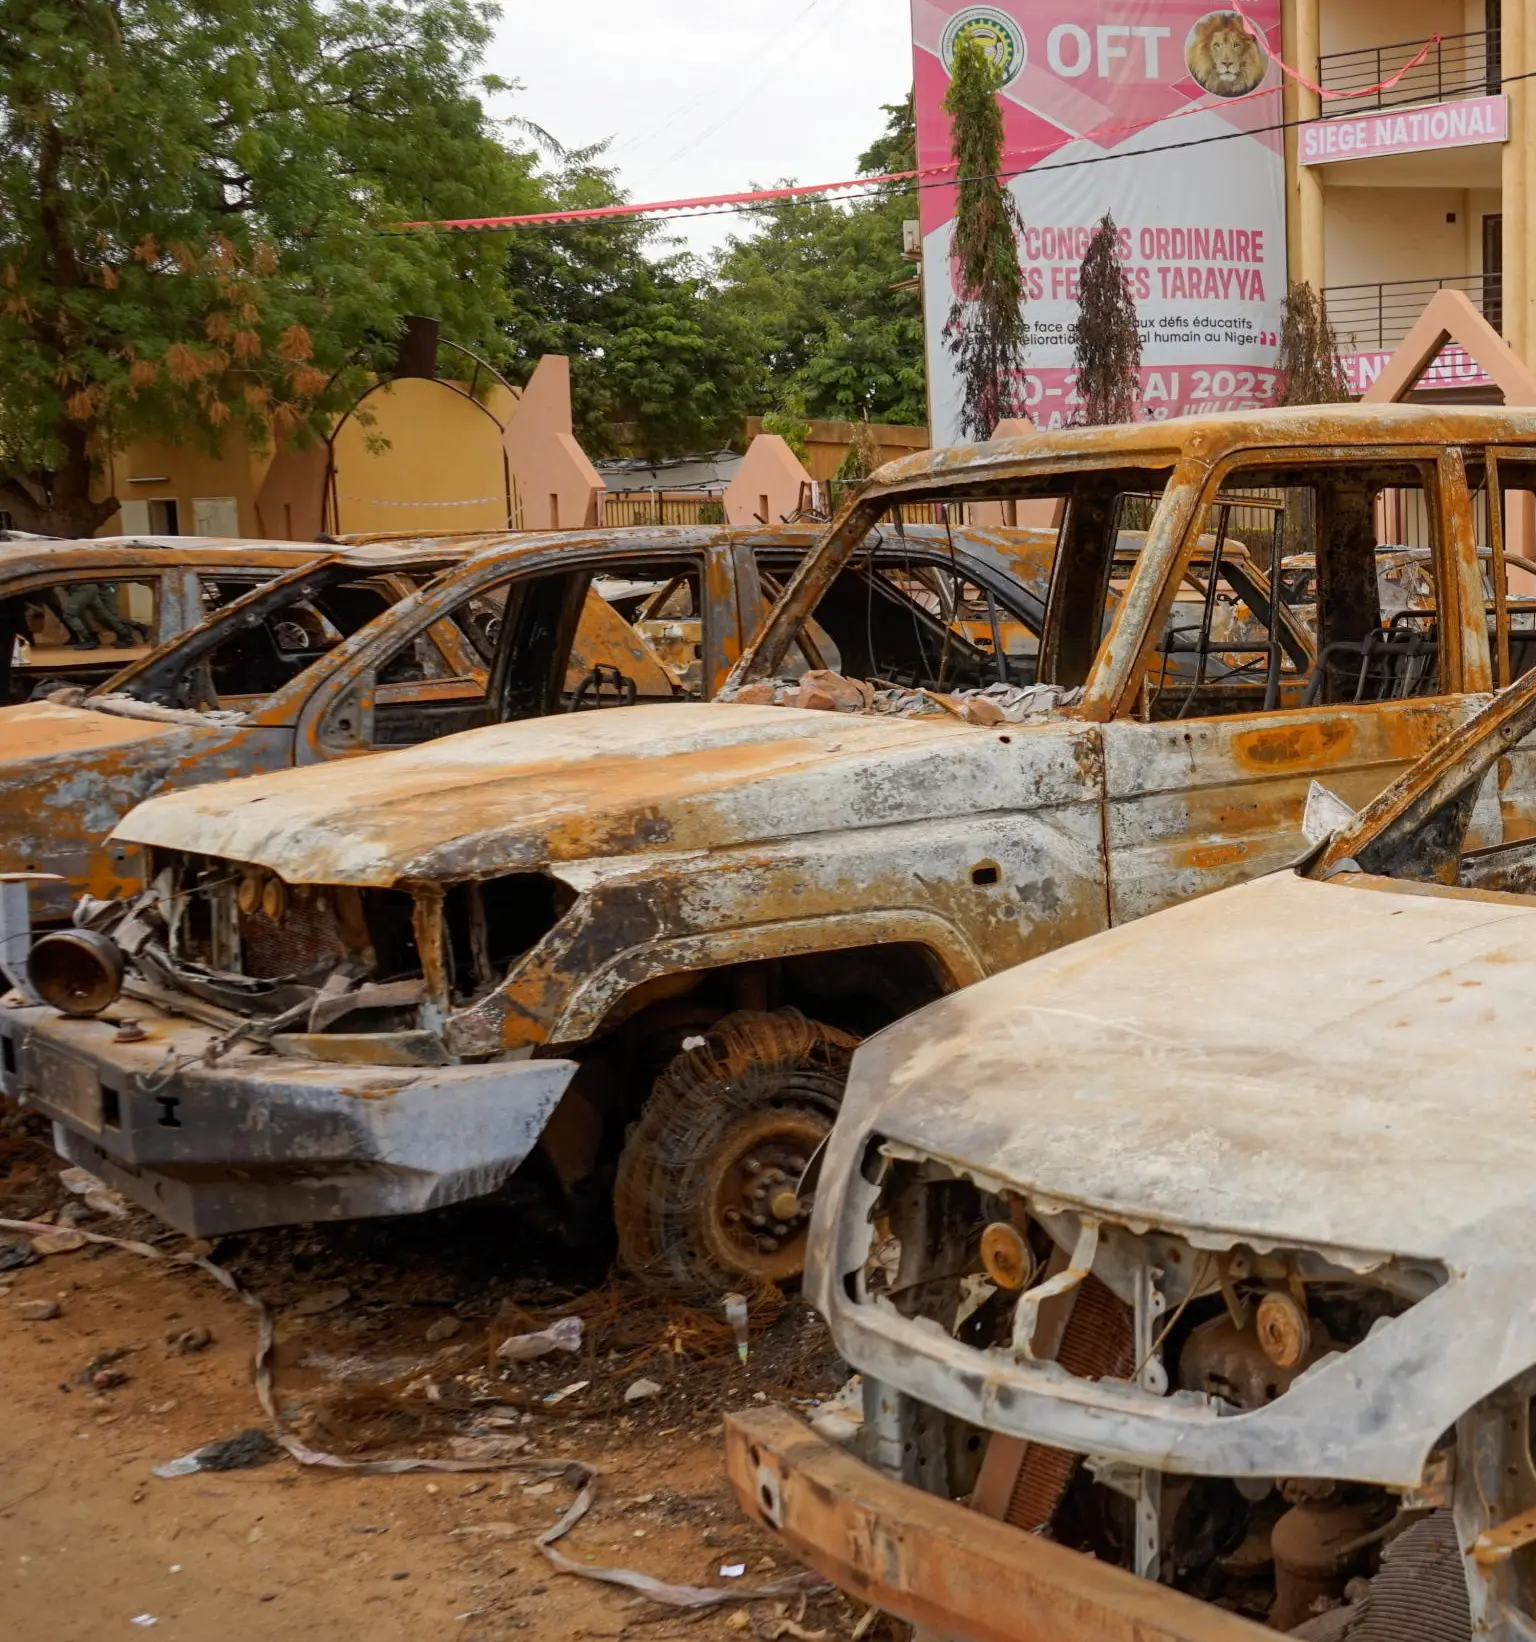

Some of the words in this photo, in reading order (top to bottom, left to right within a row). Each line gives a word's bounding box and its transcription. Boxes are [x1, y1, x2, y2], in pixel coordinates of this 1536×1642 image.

[1046, 23, 1171, 78] OFT
[1305, 121, 1367, 156] SIEGE
[1375, 104, 1496, 146] NATIONAL
[1026, 226, 1133, 262] CONGS
[1140, 227, 1264, 263] ORDINAIRE
[1051, 267, 1150, 301] FEES
[1157, 266, 1265, 302] TARAYYA
[1035, 321, 1063, 333] face
[1158, 315, 1189, 329] défis
[1192, 315, 1253, 330] éducatifs
[1154, 331, 1200, 343] humain
[1205, 333, 1221, 343] au
[1225, 331, 1258, 346] Niger
[1131, 372, 1180, 402] AI
[1189, 370, 1277, 403] 2023
